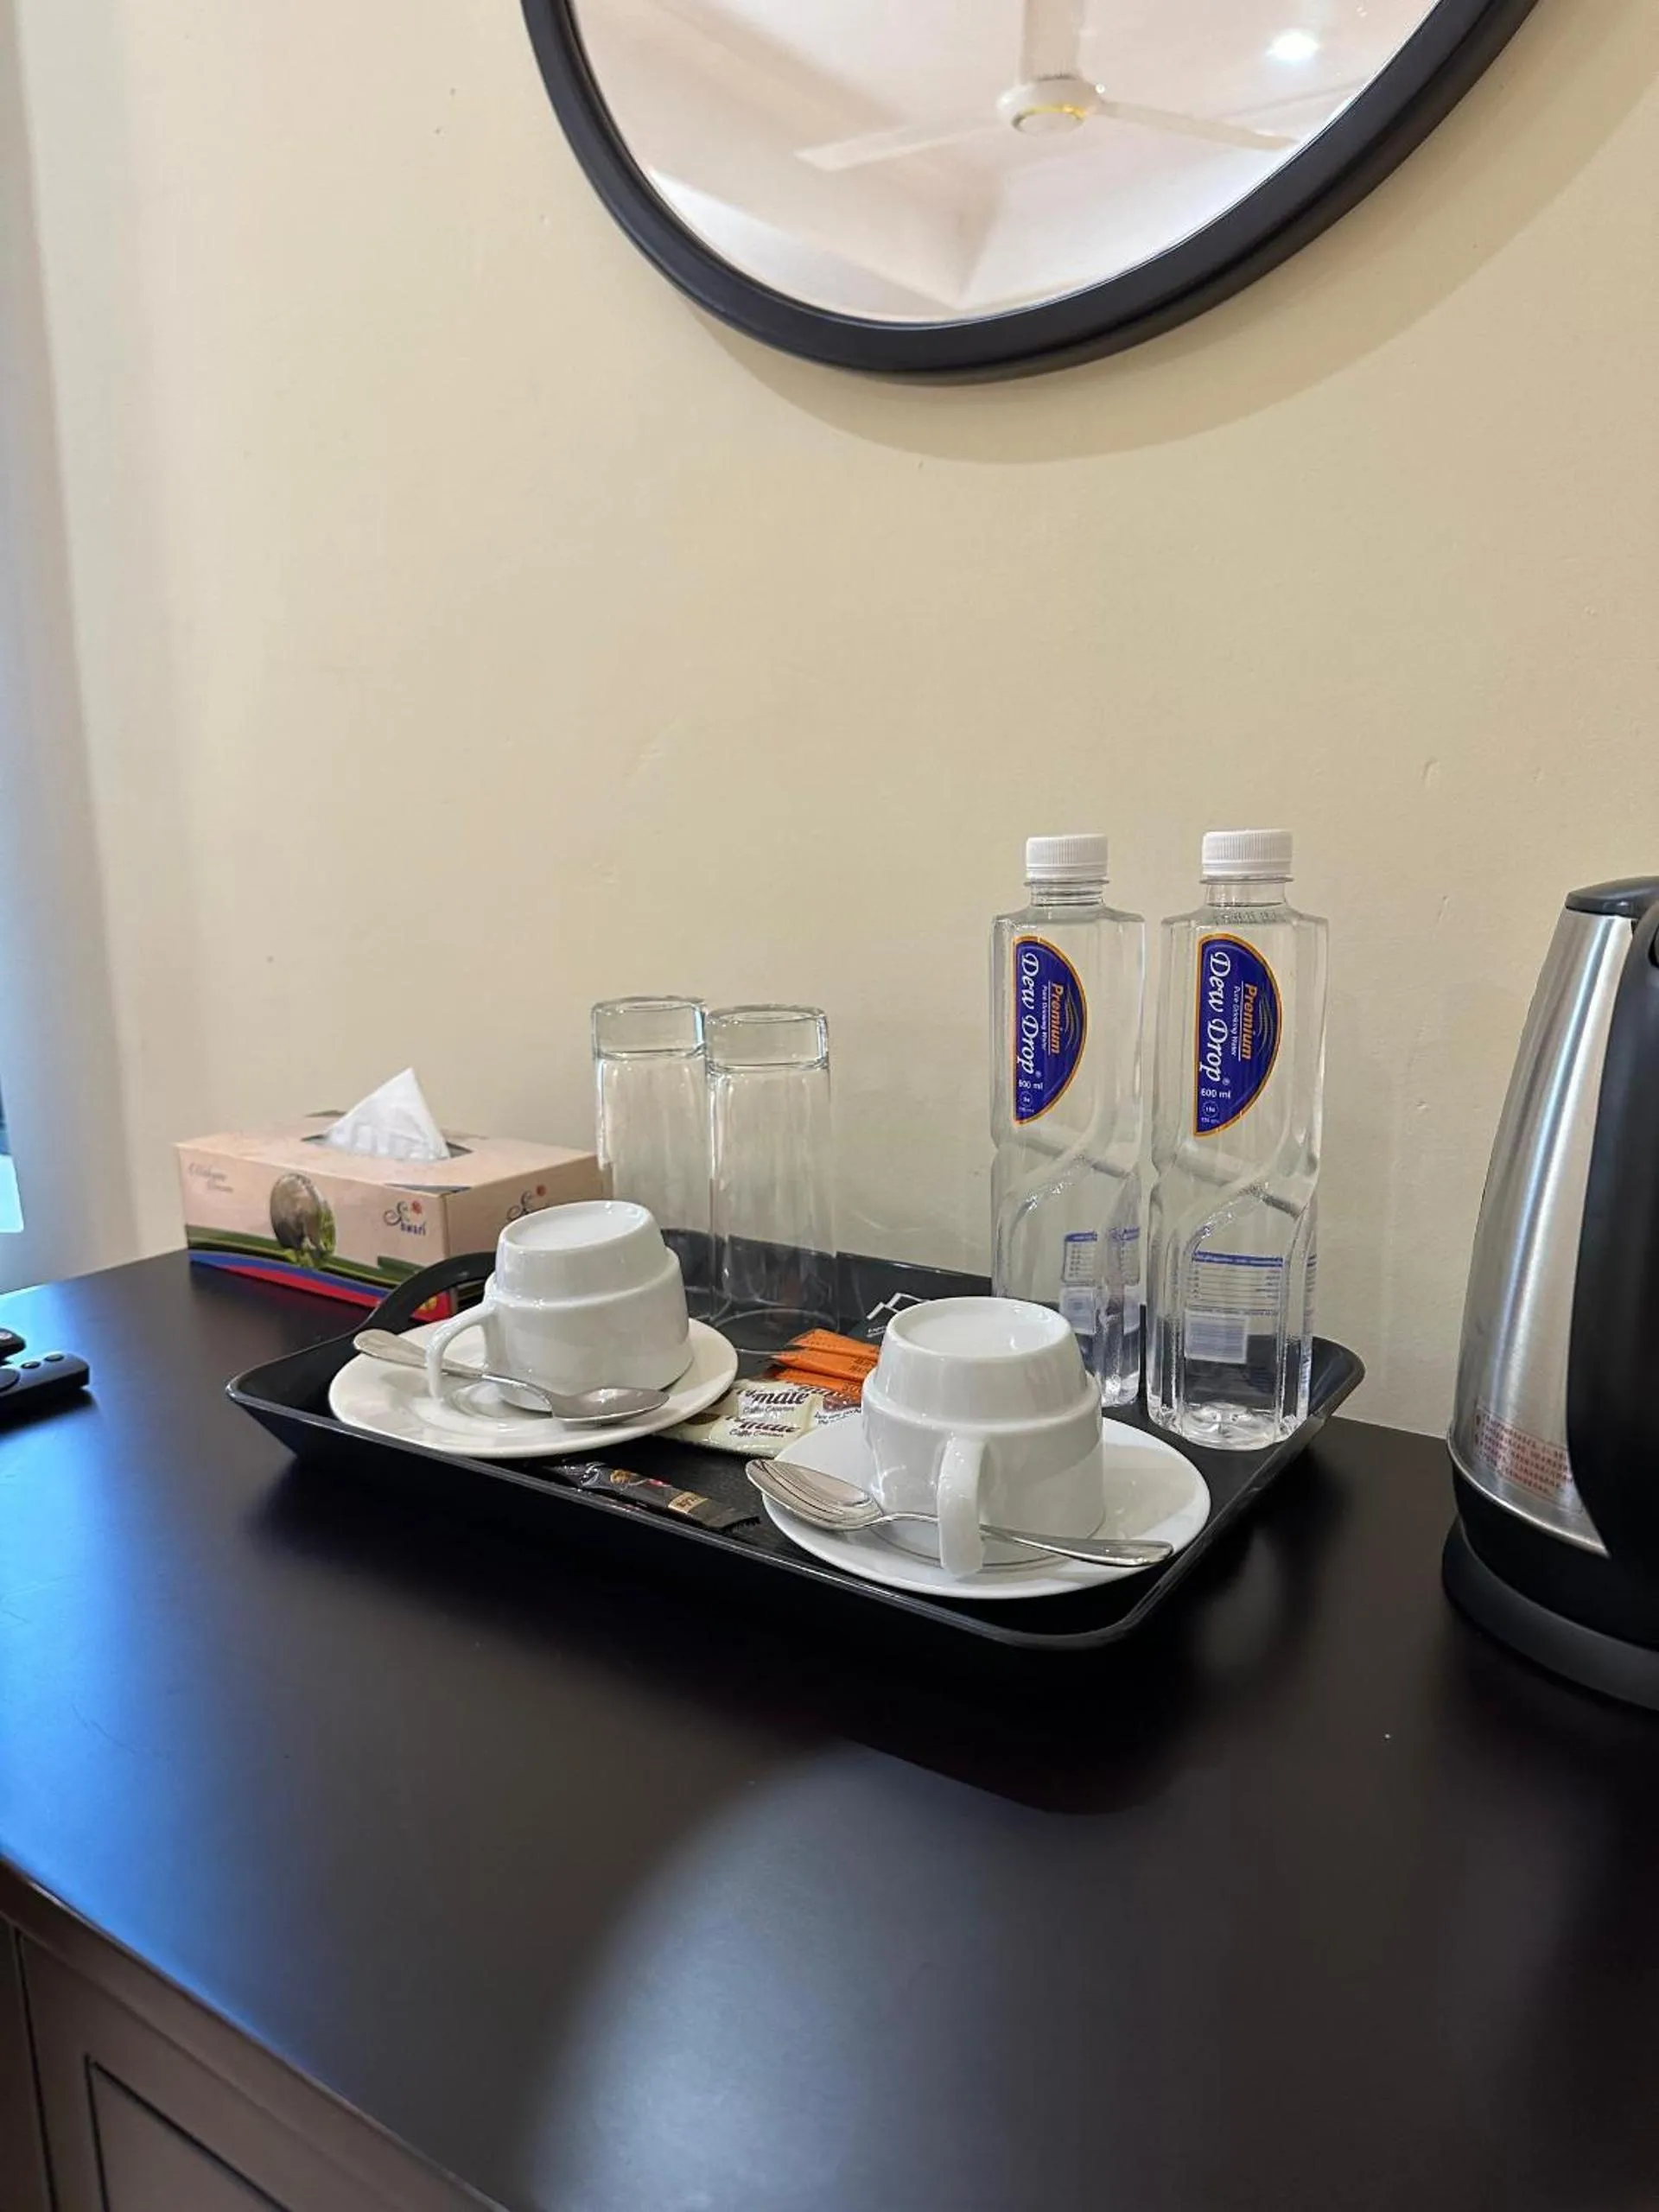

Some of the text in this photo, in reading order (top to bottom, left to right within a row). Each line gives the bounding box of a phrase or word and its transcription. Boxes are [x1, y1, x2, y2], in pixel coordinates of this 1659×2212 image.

[1017, 952, 1039, 1075] Dew Drop
[1051, 982, 1064, 1055] Premium
[1198, 951, 1230, 1082] Dew Drop
[1242, 982, 1258, 1060] Premium
